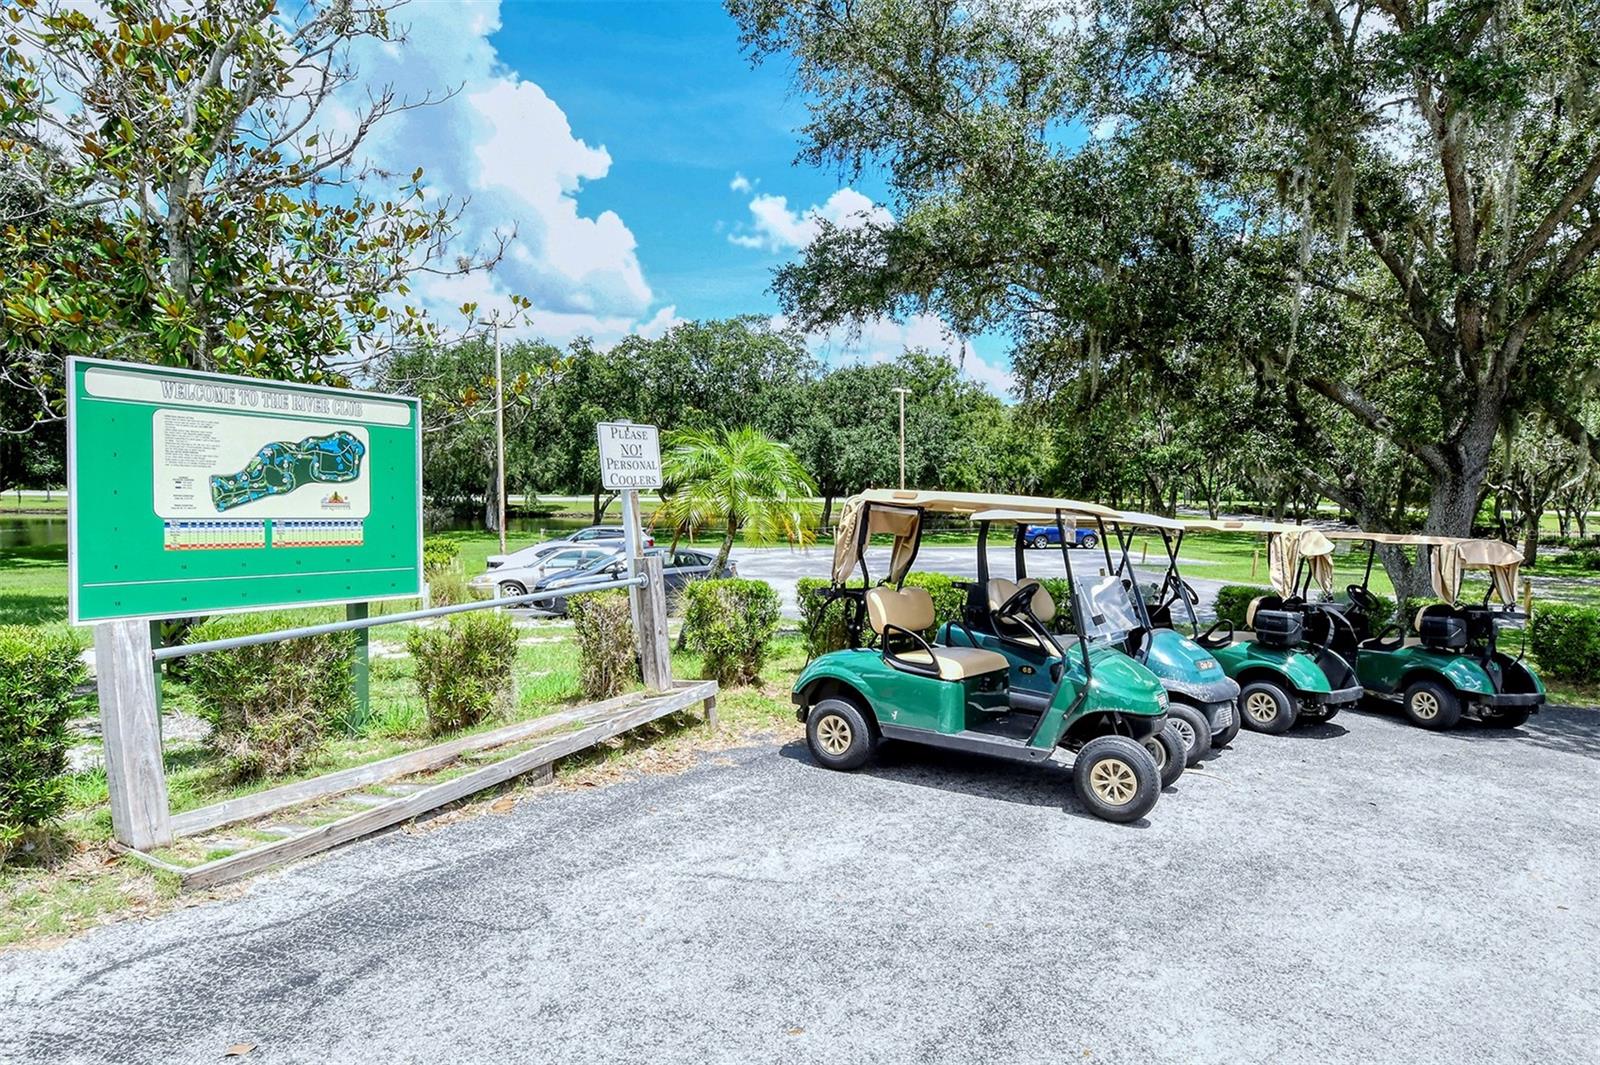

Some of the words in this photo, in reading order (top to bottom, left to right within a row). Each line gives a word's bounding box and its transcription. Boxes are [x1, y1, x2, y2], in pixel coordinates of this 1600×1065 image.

[161, 380, 236, 405] WELCOME
[239, 389, 259, 407] TO
[262, 391, 290, 410] THE
[291, 394, 331, 414] RIVER
[331, 399, 363, 417] CLUB
[610, 427, 648, 440] PLEASE
[621, 444, 642, 456] NO!
[606, 458, 657, 470] PERSONAL
[610, 473, 657, 485] COOLERS
